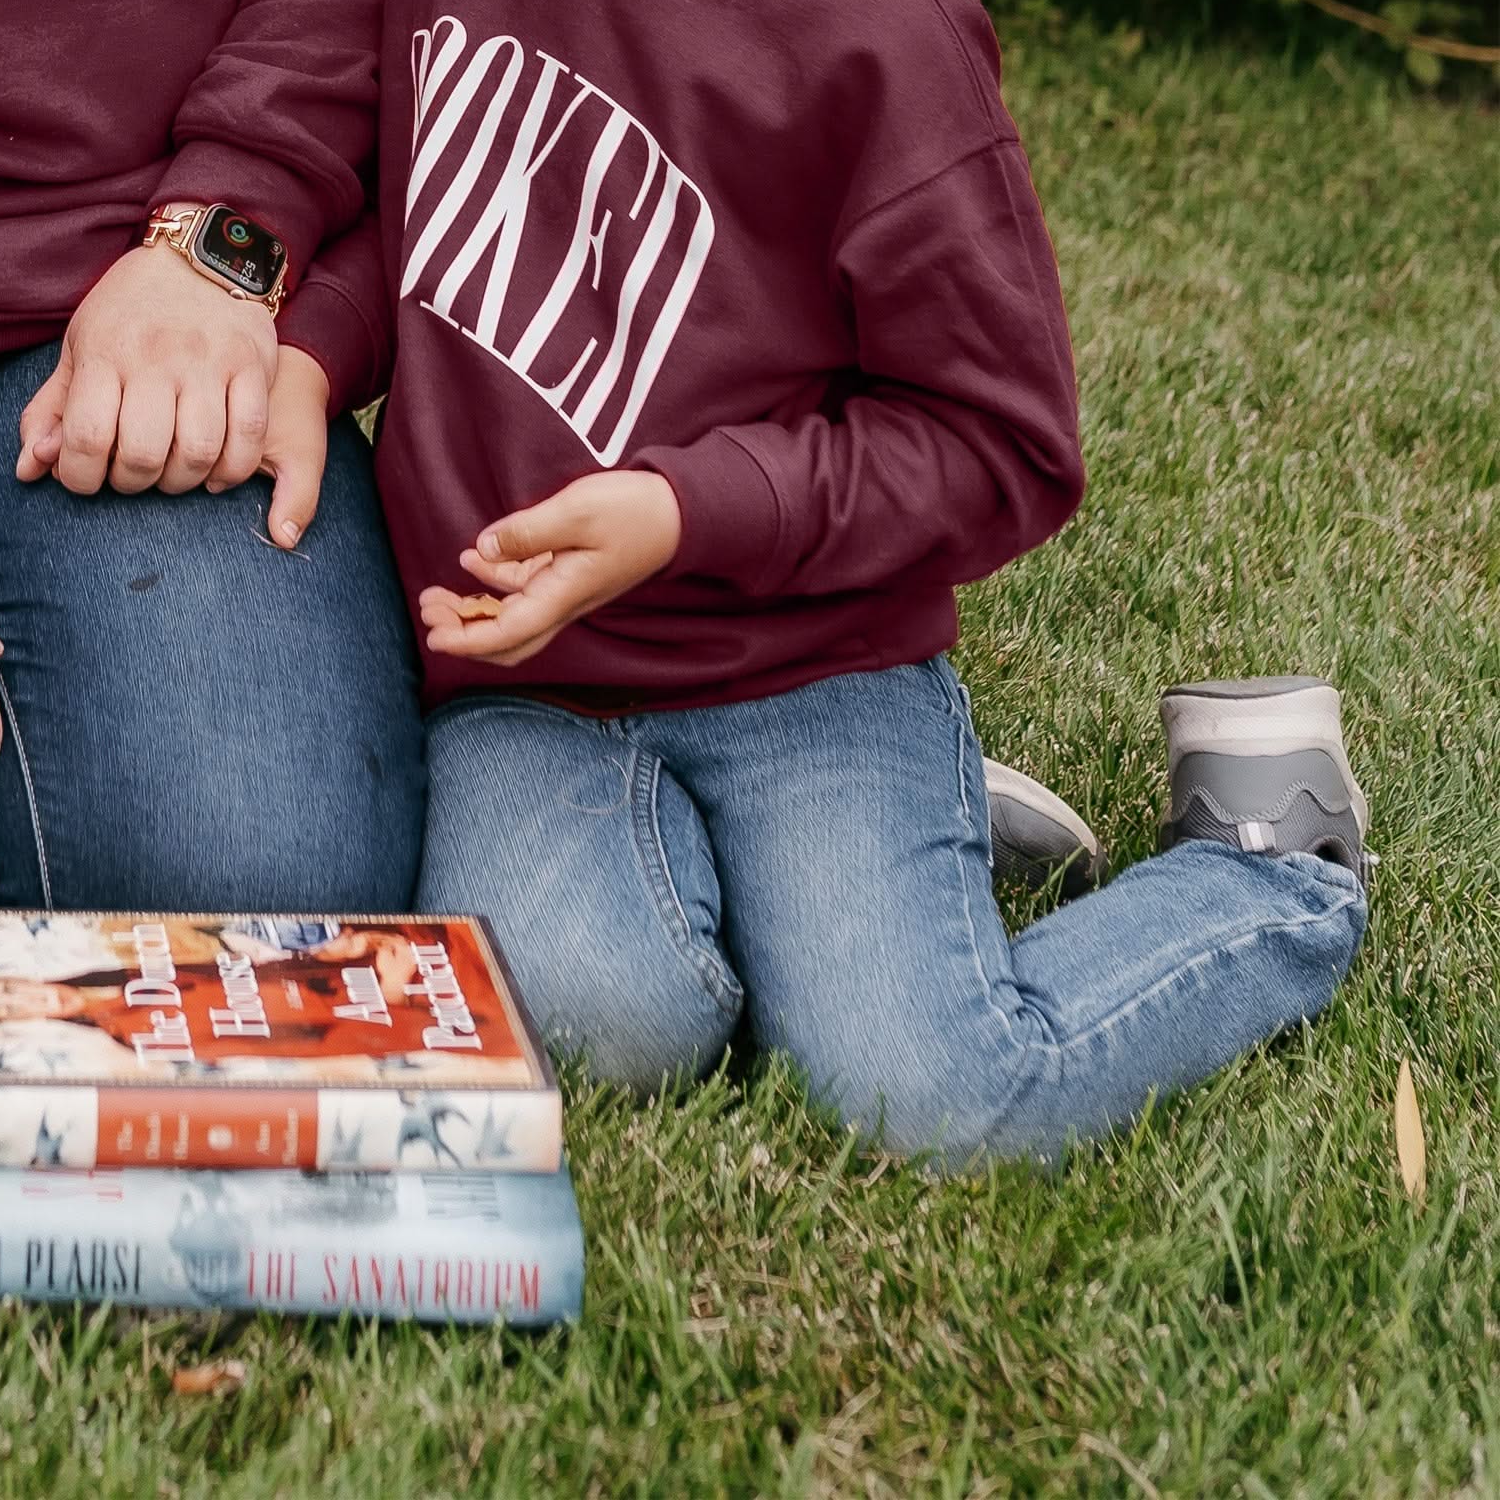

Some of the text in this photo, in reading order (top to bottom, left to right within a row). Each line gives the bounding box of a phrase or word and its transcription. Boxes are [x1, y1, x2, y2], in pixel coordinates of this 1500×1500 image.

[239, 260, 256, 285] 5:29
[112, 924, 182, 1007] Dutch
[209, 952, 271, 1038] House
[332, 966, 393, 1028] Ann
[132, 1010, 195, 1065] The
[246, 1250, 541, 1316] THE SANATORIUM
